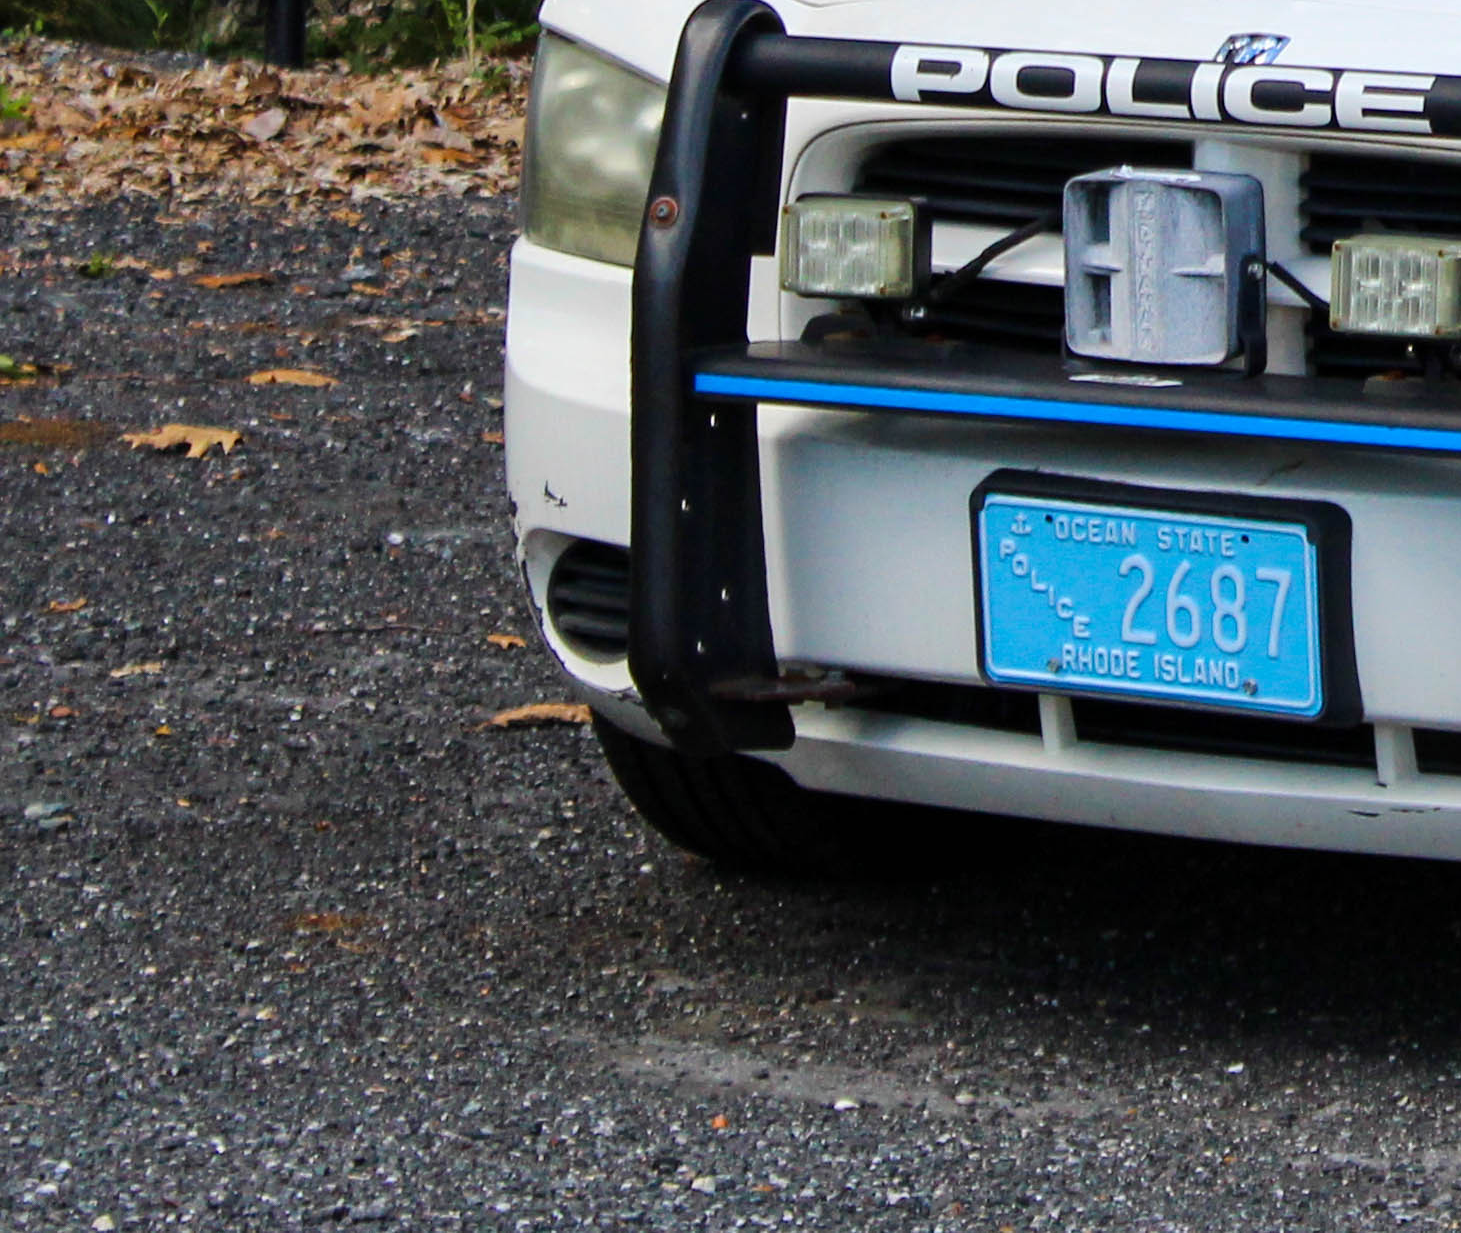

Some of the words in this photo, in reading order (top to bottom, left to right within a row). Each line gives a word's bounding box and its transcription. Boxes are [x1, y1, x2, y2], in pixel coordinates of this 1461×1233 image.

[890, 43, 1435, 134] POLICE
[1053, 515, 1137, 546] OCEAN
[1157, 527, 1236, 558] STATE
[999, 539, 1091, 638] POLICE
[1118, 553, 1292, 659] 2687
[1061, 643, 1141, 678] RHODE
[1153, 654, 1241, 690] ISLAND
